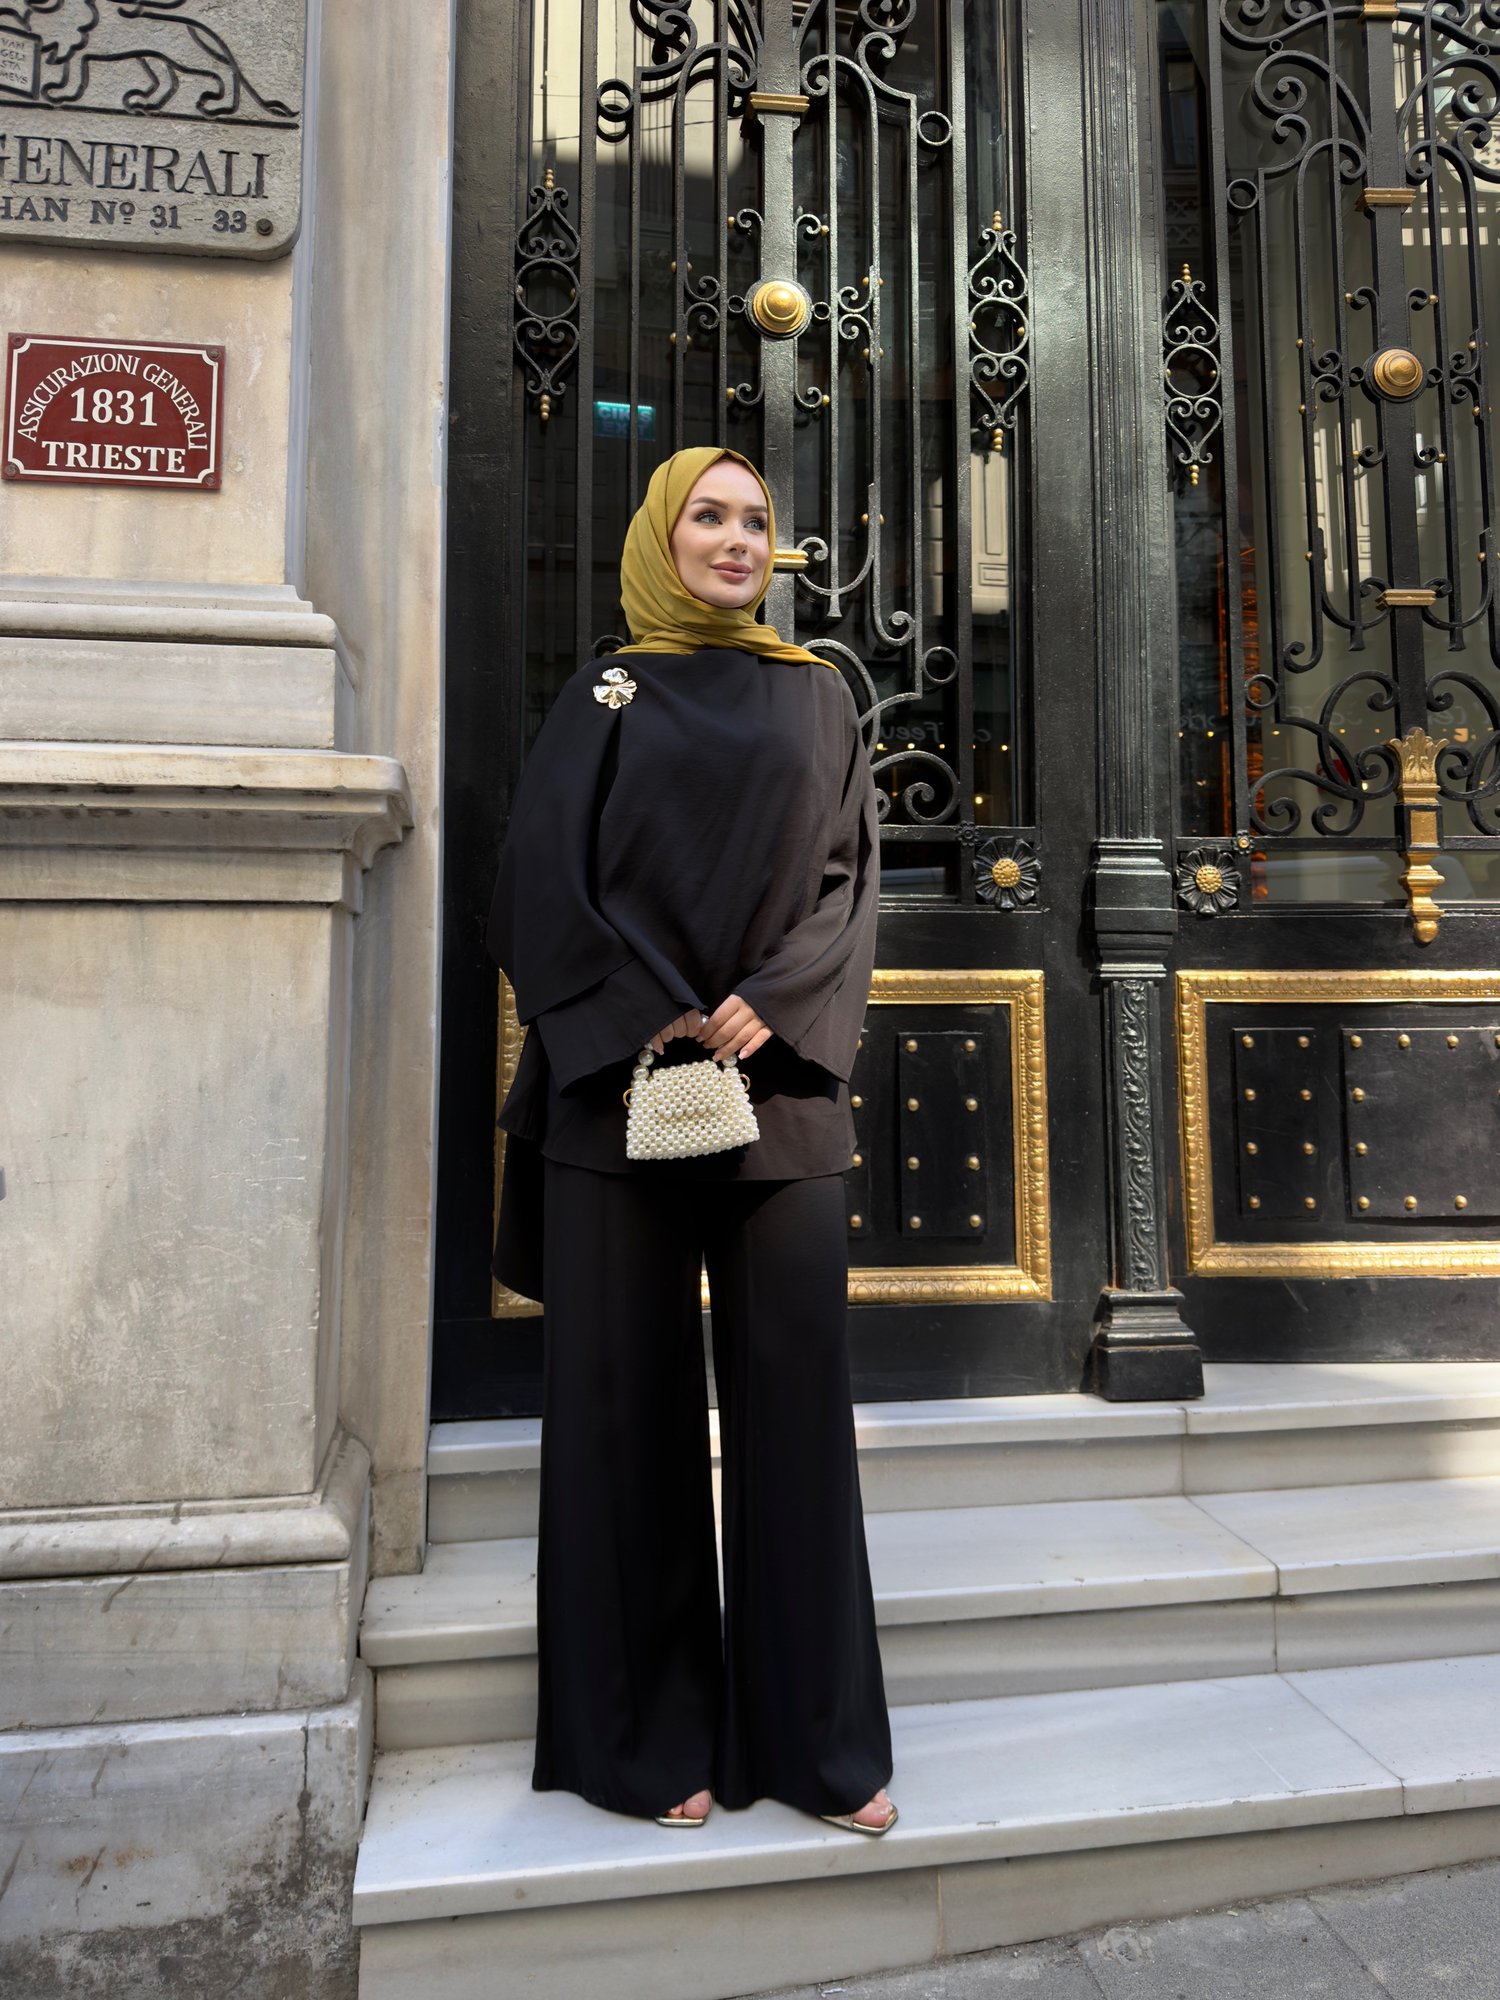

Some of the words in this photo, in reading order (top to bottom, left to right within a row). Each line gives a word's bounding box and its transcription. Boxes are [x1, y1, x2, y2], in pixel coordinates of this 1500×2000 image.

[0, 133, 270, 199] ENERALI
[150, 205, 181, 230] 31
[212, 209, 248, 234] 33
[17, 353, 141, 442] ASSICURAZIONI
[142, 363, 208, 450] GENERALI
[71, 387, 158, 427] 1831
[602, 420, 649, 437] EXT
[41, 440, 187, 474] TRIESTE
